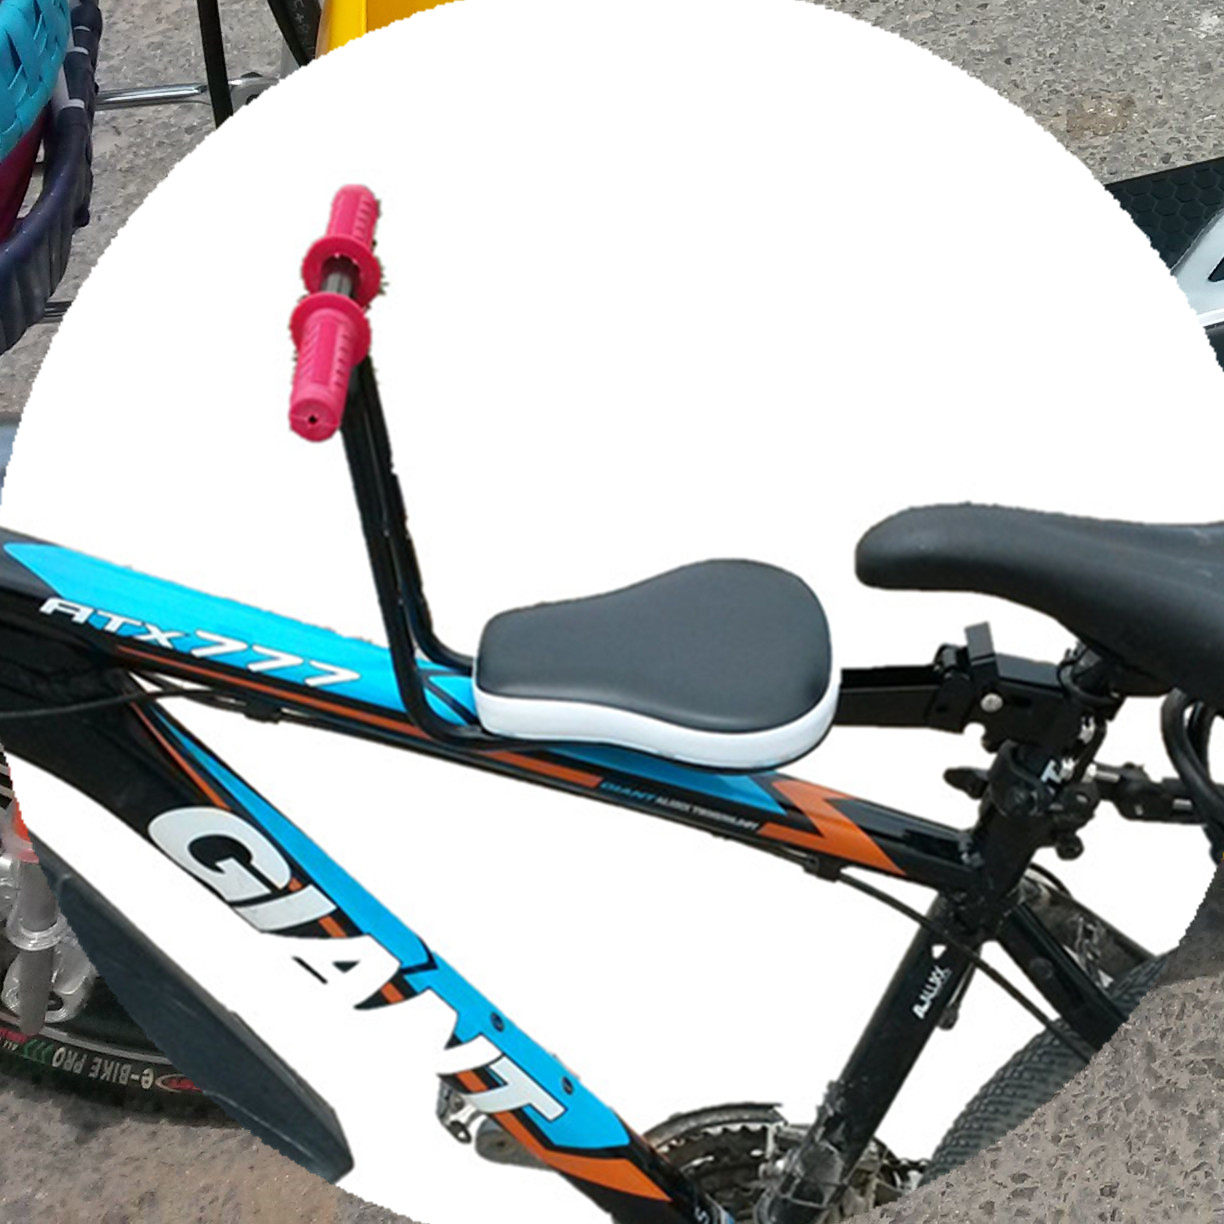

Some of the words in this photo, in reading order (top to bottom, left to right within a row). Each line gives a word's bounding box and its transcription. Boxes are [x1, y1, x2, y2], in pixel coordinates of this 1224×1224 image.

[148, 806, 567, 1123] GIANT
[51, 1046, 88, 1075] PRO
[87, 1055, 155, 1090] e-BIKE
